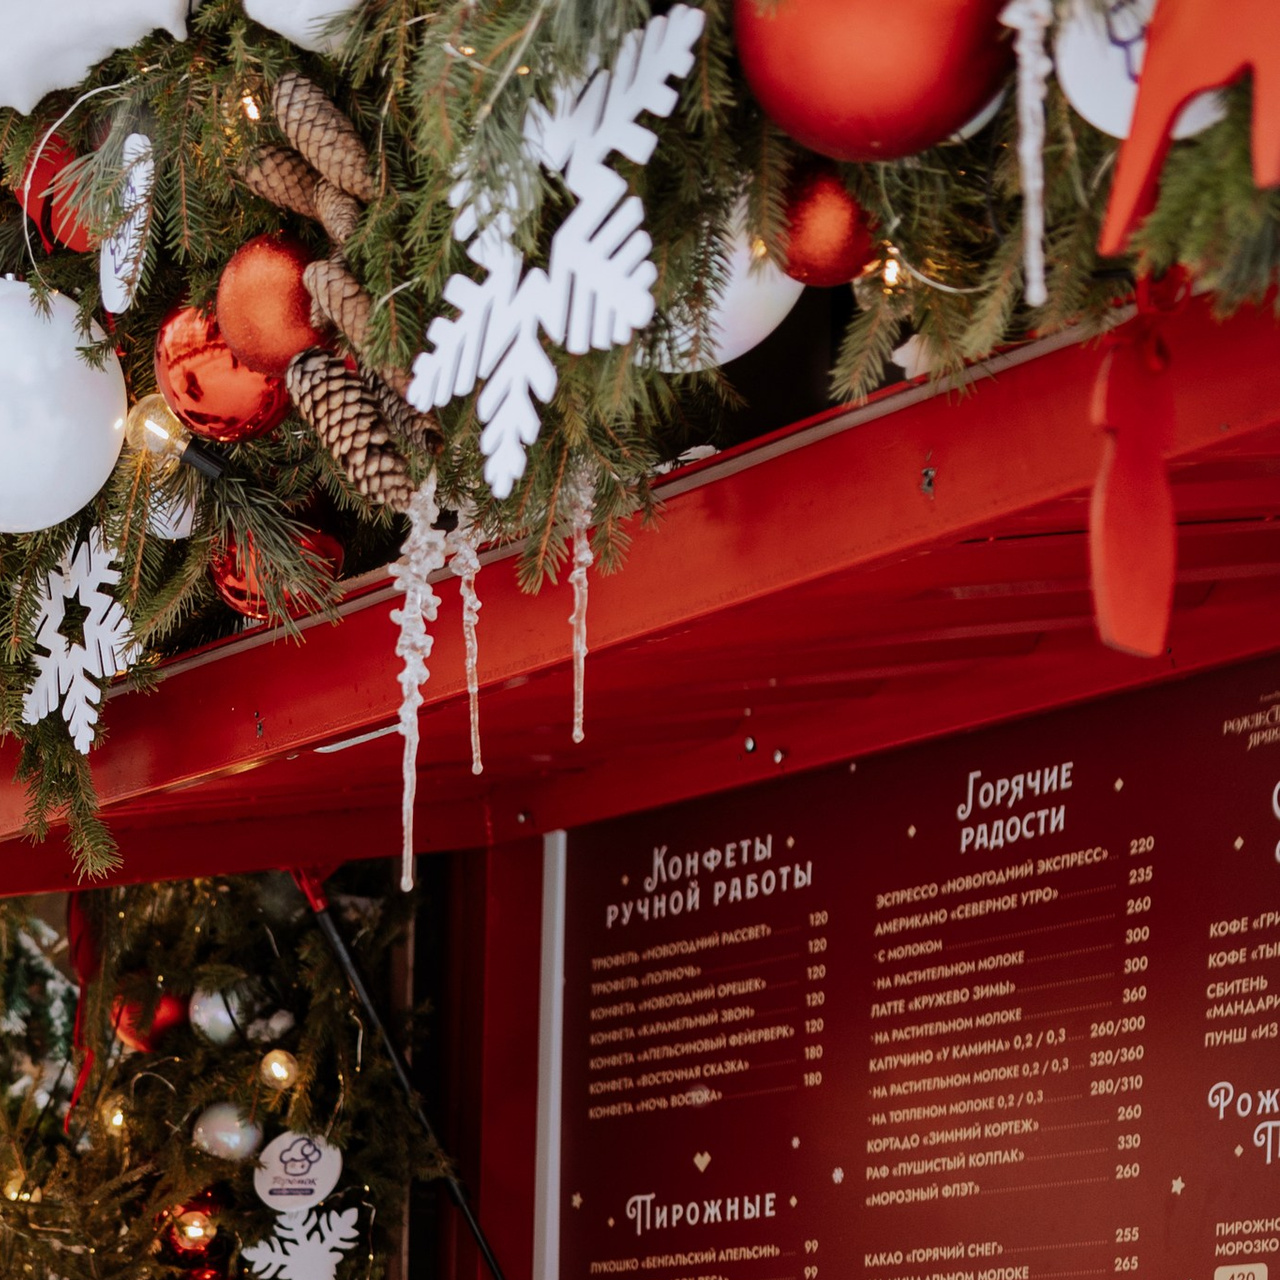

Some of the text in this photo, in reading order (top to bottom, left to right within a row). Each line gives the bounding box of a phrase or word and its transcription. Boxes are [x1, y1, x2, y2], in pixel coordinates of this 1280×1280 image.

[1130, 836, 1154, 855] 220
[1129, 866, 1152, 885] 235
[1127, 896, 1151, 914] 260
[1126, 926, 1149, 944] 300
[1124, 956, 1148, 974] 300
[805, 1018, 824, 1033] 120
[1091, 1015, 1145, 1038] 260/300
[805, 1045, 823, 1059] 180
[1091, 1075, 1142, 1095] 280/310
[1118, 1104, 1141, 1121] 260
[1118, 1134, 1140, 1150] 330
[1116, 1163, 1139, 1179] 260
[1116, 1227, 1139, 1242] 255
[805, 1240, 818, 1253] 99
[1115, 1256, 1138, 1271] 265
[804, 1266, 818, 1279] 99
